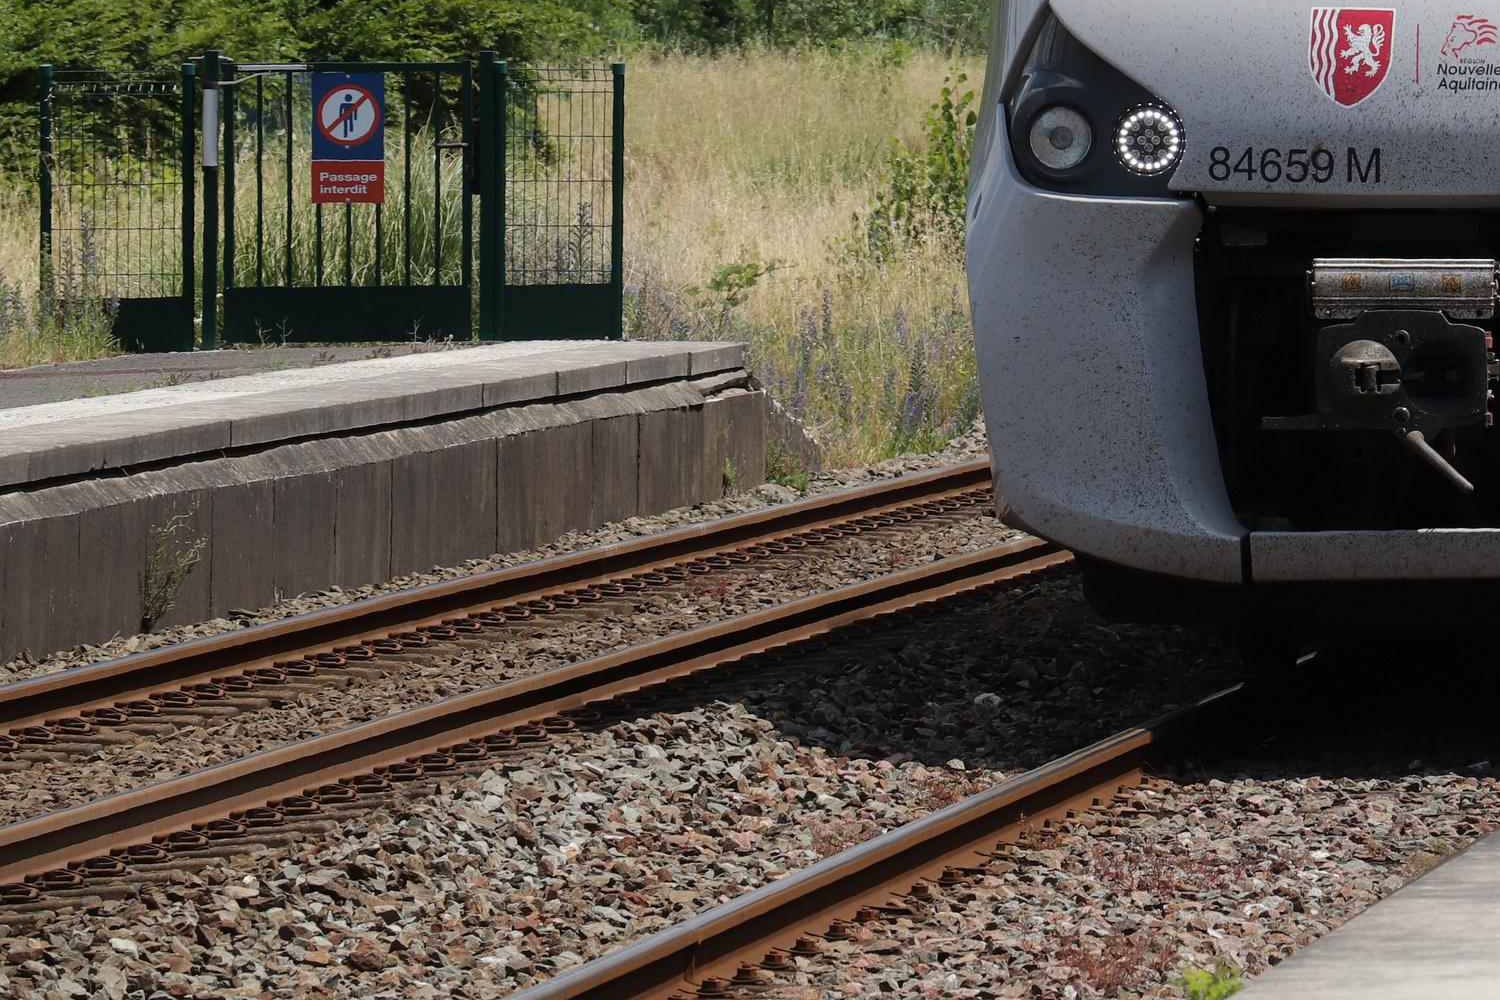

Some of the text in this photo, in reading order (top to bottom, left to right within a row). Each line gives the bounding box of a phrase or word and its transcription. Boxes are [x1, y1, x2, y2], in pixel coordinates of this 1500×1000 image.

[1208, 146, 1382, 183] 84659 M
[319, 171, 378, 184] Passage
[319, 184, 368, 195] interdit
